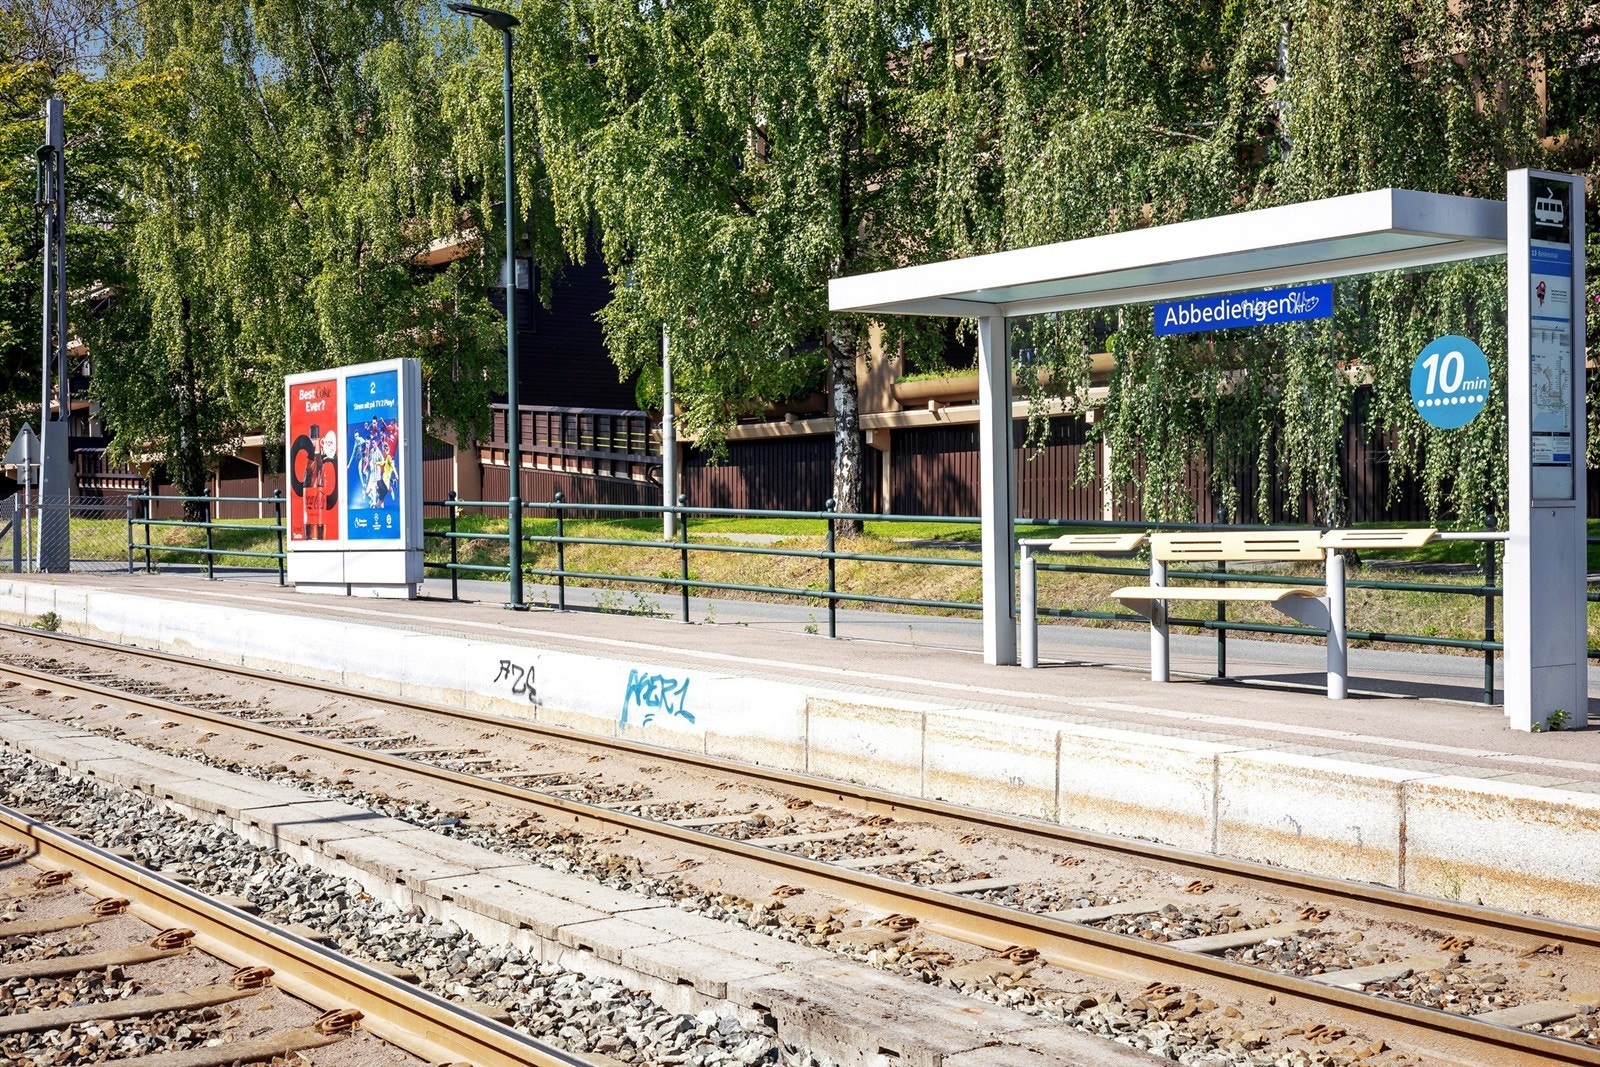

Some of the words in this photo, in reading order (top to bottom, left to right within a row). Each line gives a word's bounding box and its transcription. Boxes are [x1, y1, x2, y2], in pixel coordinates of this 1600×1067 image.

[1163, 298, 1290, 327] Abbediengen
[1422, 350, 1465, 395] 10
[1462, 376, 1487, 391] min
[299, 388, 316, 401] Best
[316, 386, 331, 399] Coke
[370, 381, 376, 394] 2
[305, 400, 325, 412] Ever?
